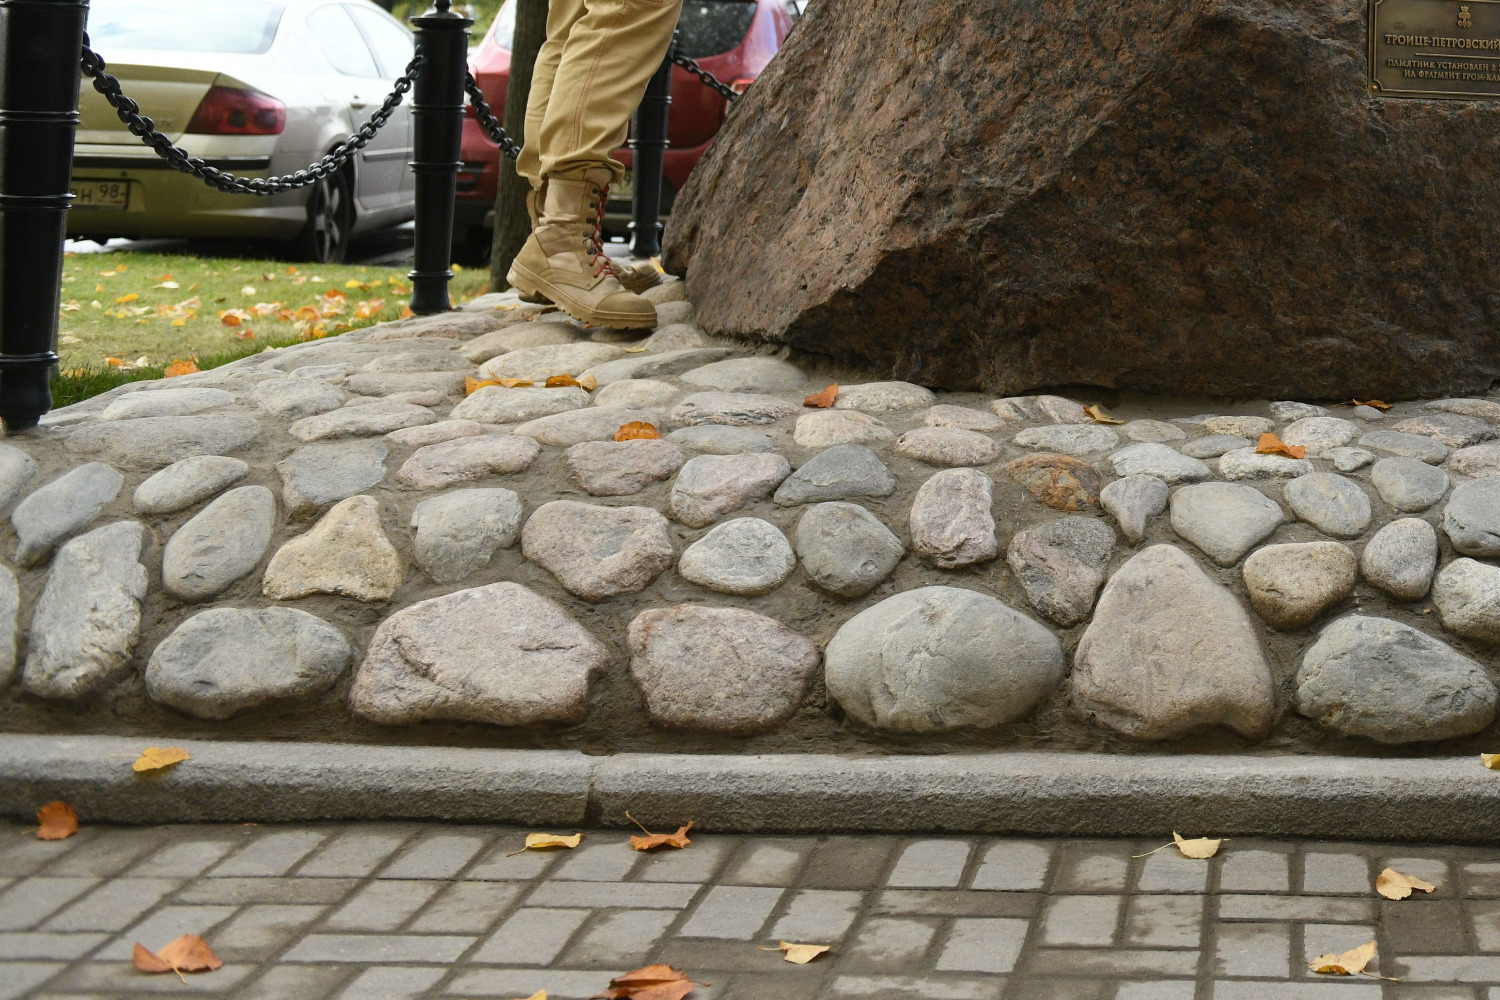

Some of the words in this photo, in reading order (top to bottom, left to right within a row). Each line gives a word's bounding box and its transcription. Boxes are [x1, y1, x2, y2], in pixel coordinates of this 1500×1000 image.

[1387, 59, 1435, 69] ПАМЯТНИК
[1437, 61, 1489, 71] УСТАНОВЛЕН
[1490, 64, 1496, 72] В
[1404, 70, 1416, 78] НА
[1418, 71, 1460, 80] ФРАГМЕНТ
